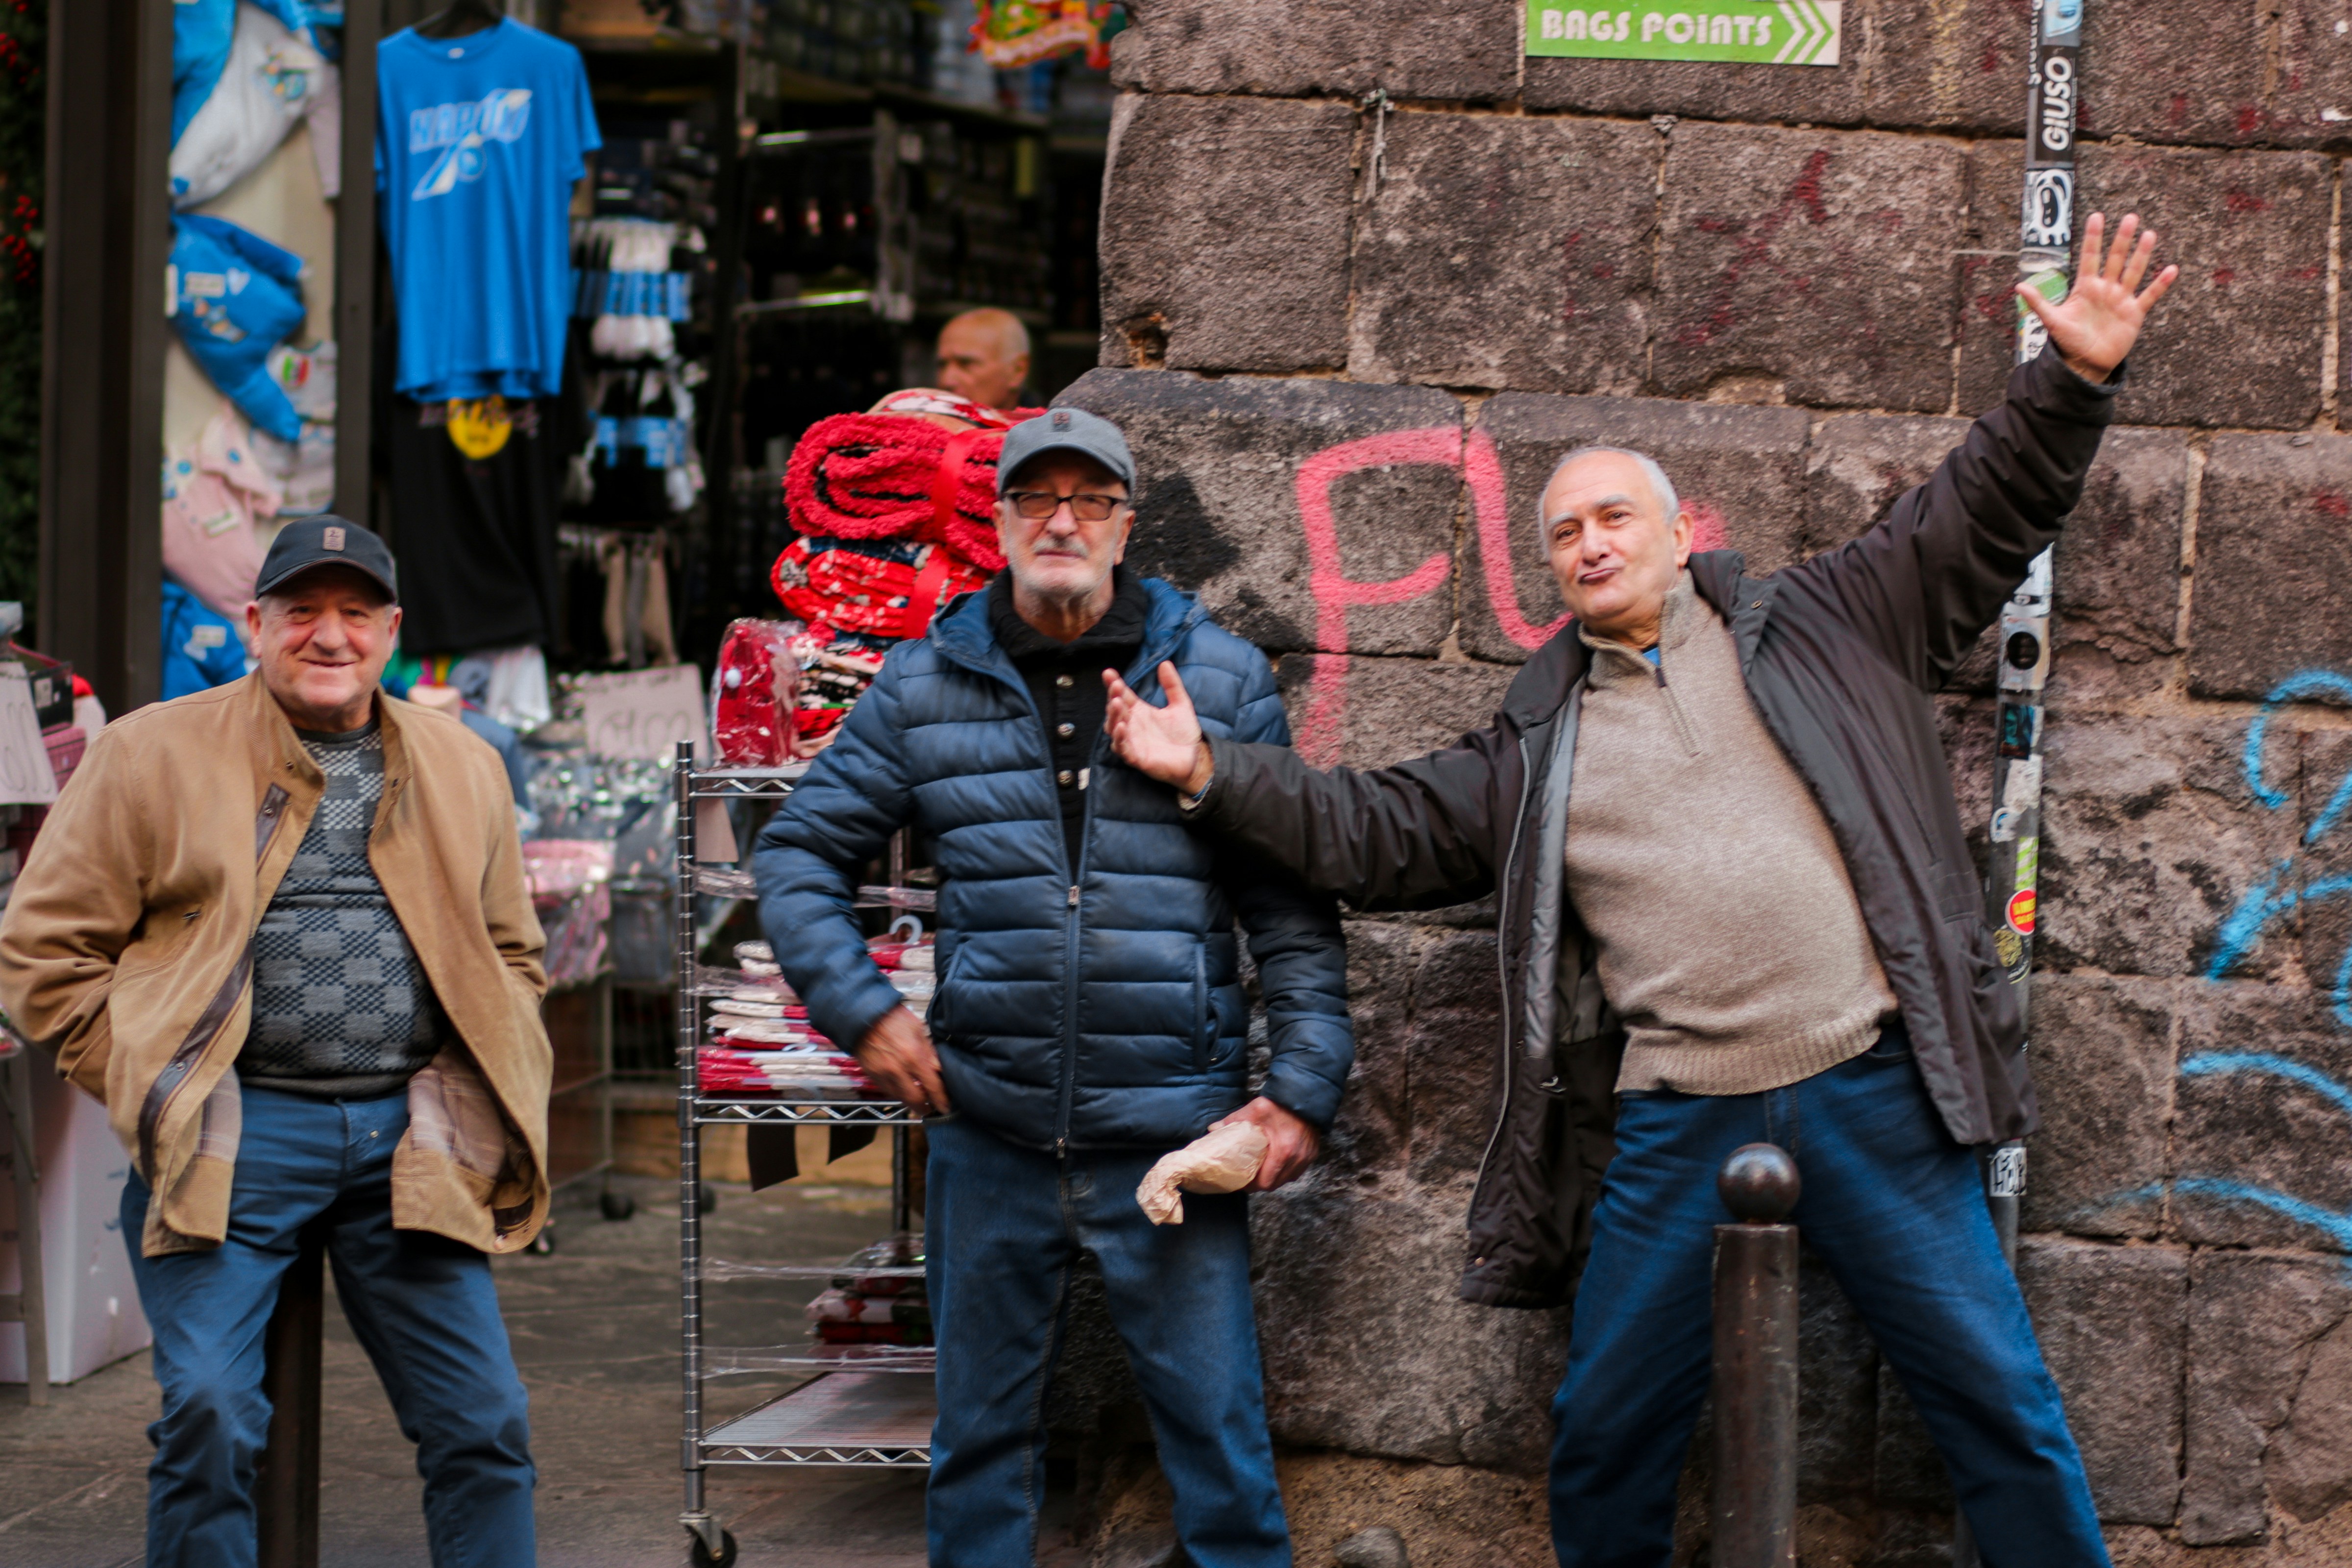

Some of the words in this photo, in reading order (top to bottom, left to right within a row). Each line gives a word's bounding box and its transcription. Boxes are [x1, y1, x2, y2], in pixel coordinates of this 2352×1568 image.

[1541, 9, 1631, 41] BAGS
[1641, 12, 1772, 46] POINTS
[2042, 56, 2072, 151] GIUSO
